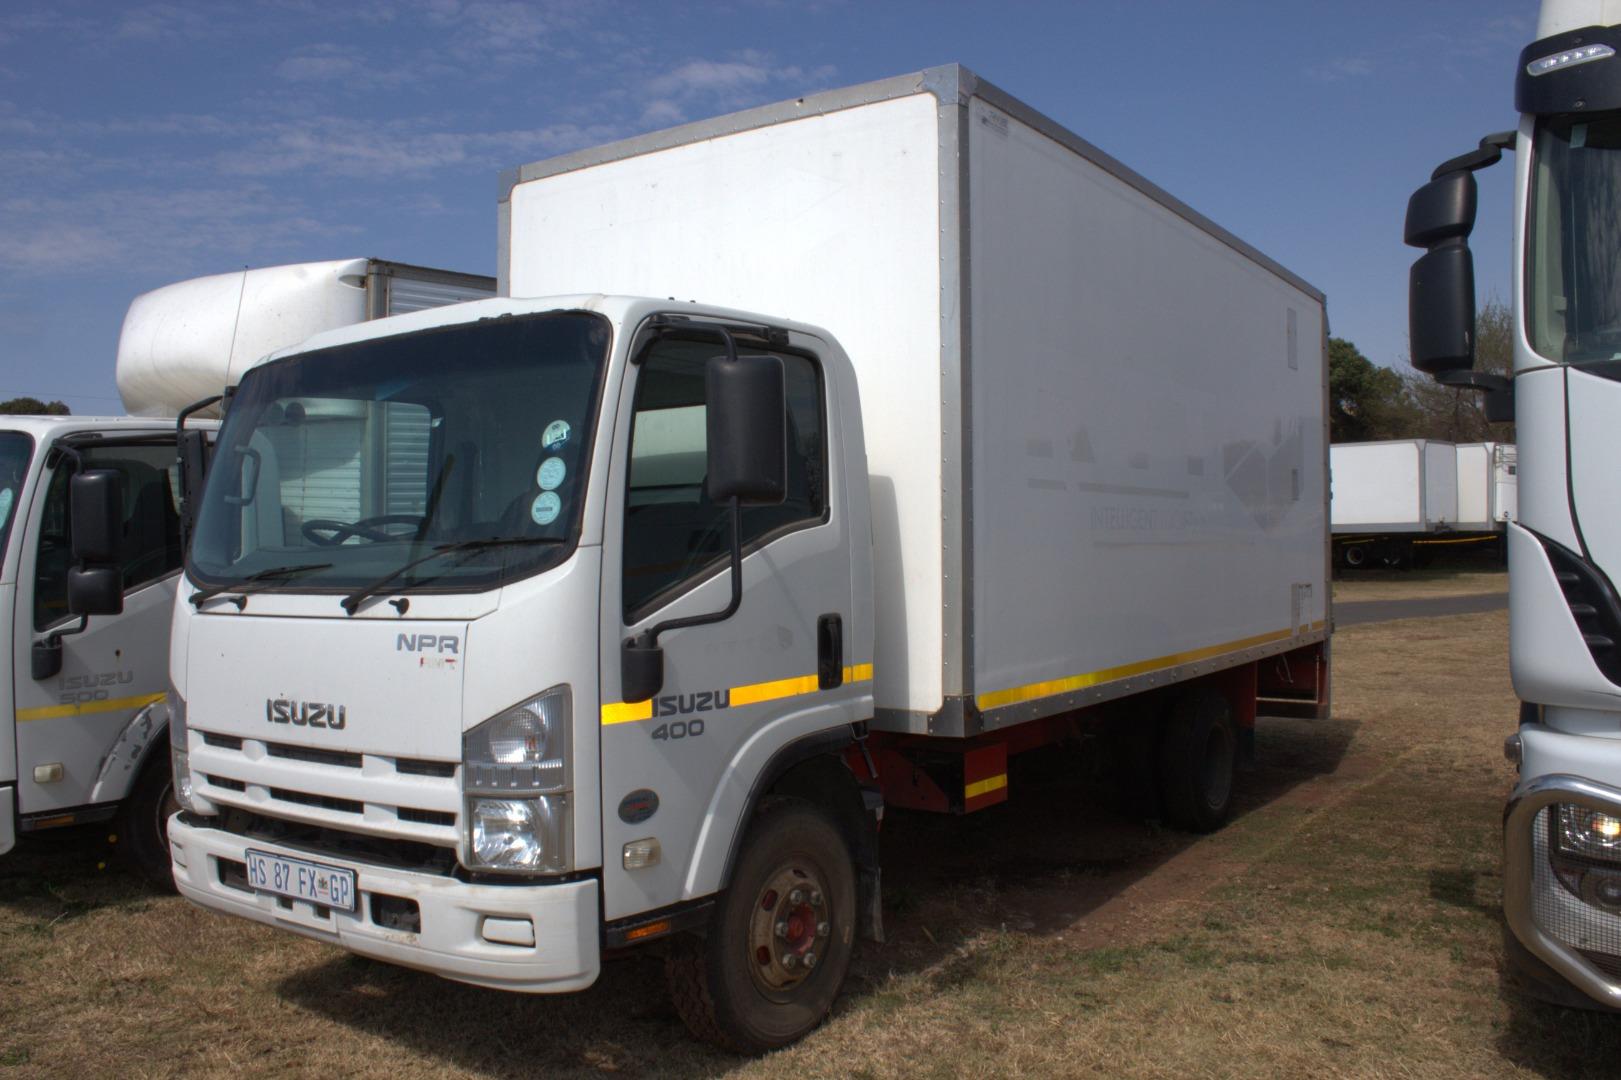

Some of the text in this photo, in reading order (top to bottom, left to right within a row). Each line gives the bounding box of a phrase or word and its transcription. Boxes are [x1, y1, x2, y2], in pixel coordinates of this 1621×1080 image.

[397, 633, 459, 654] NPR
[59, 670, 133, 690] ISUZU
[266, 699, 346, 730] ISUZU
[652, 689, 730, 717] ISUZU
[651, 719, 704, 741] 400
[248, 855, 349, 904] HS 87 FX GP
